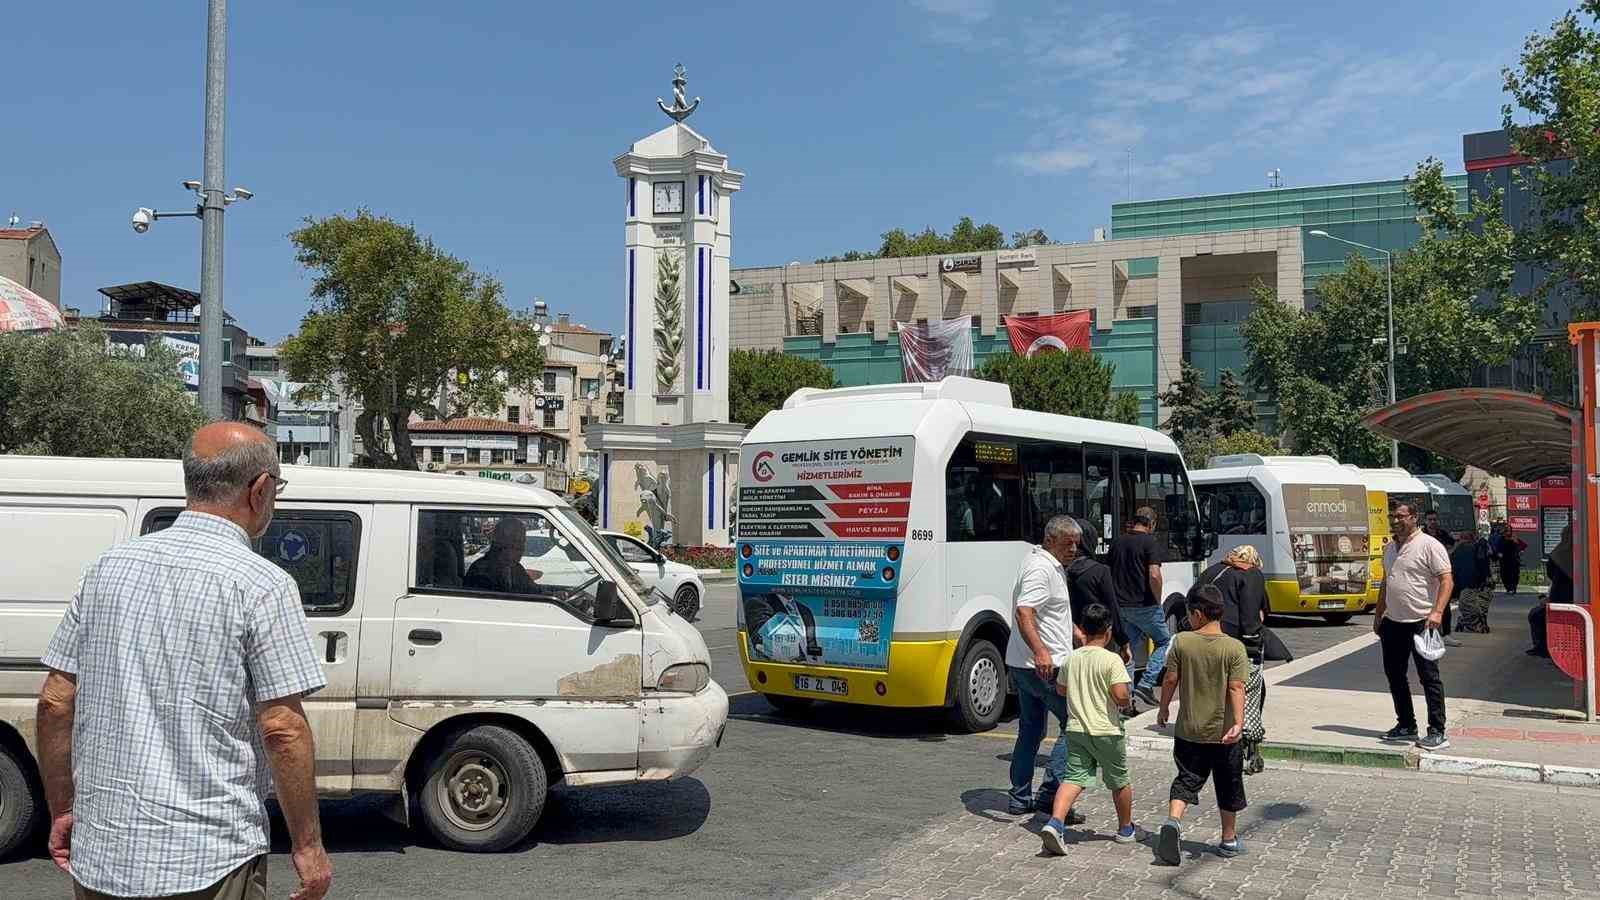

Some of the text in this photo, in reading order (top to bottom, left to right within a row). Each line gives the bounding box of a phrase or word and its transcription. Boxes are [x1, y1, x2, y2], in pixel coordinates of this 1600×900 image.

[782, 446, 902, 463] GEMLİK SİTE YÖNETİM
[797, 468, 863, 480] HİZMETLERİMİZ
[912, 530, 933, 540] 8699
[754, 544, 886, 558] SİTE ve APARTMAN YÖNETİMİNDE
[758, 558, 876, 571] PROFESYONEL HİZMET ALMAK
[782, 572, 808, 586] İSTER
[812, 574, 856, 587] MİSİNİZ?
[800, 678, 847, 693] 16 ZL 049
